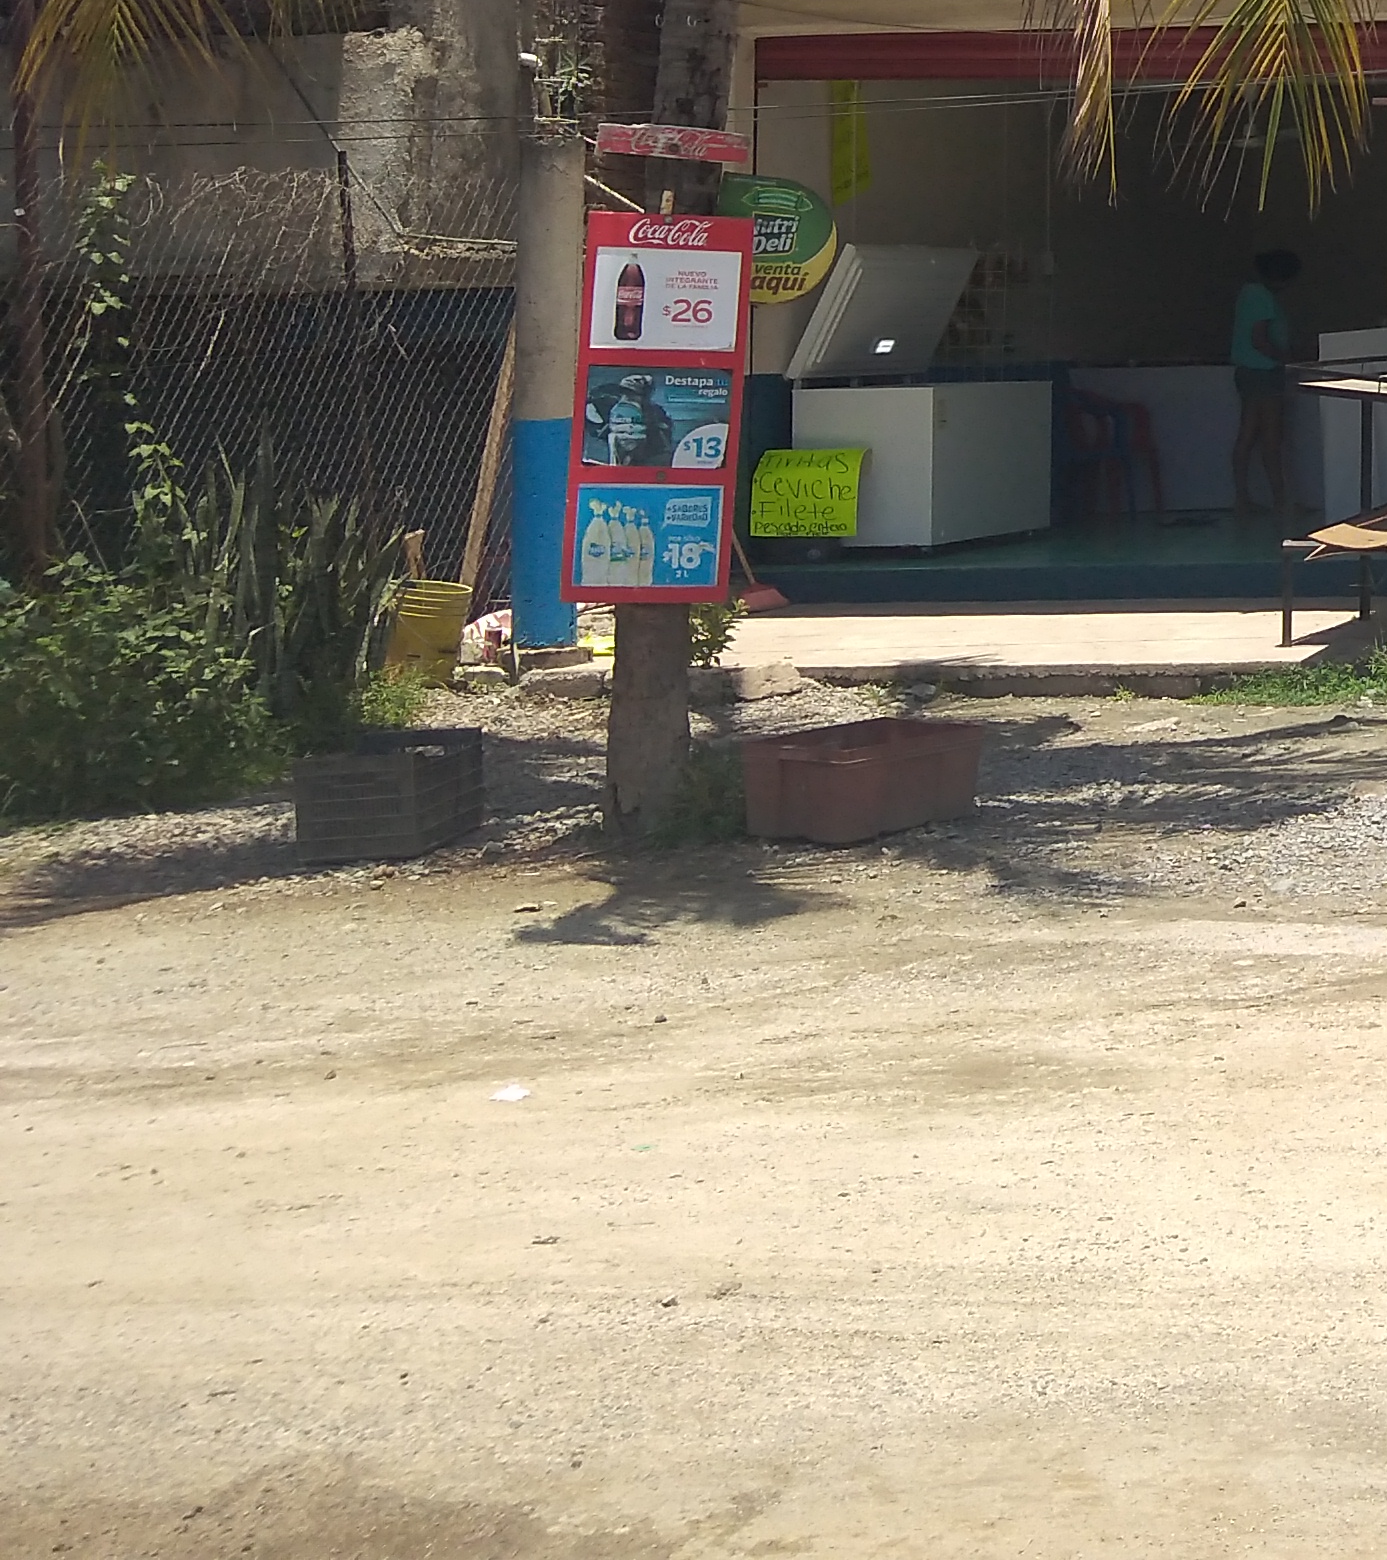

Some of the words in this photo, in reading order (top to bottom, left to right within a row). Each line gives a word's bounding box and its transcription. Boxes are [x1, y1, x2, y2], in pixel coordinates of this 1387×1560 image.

[629, 218, 714, 246] Coca-Cola
[754, 263, 802, 276] venta
[662, 298, 713, 324] $26
[665, 375, 713, 388] Destapa
[698, 388, 728, 397] regalo
[683, 436, 722, 459] $13
[662, 543, 701, 569] $18
